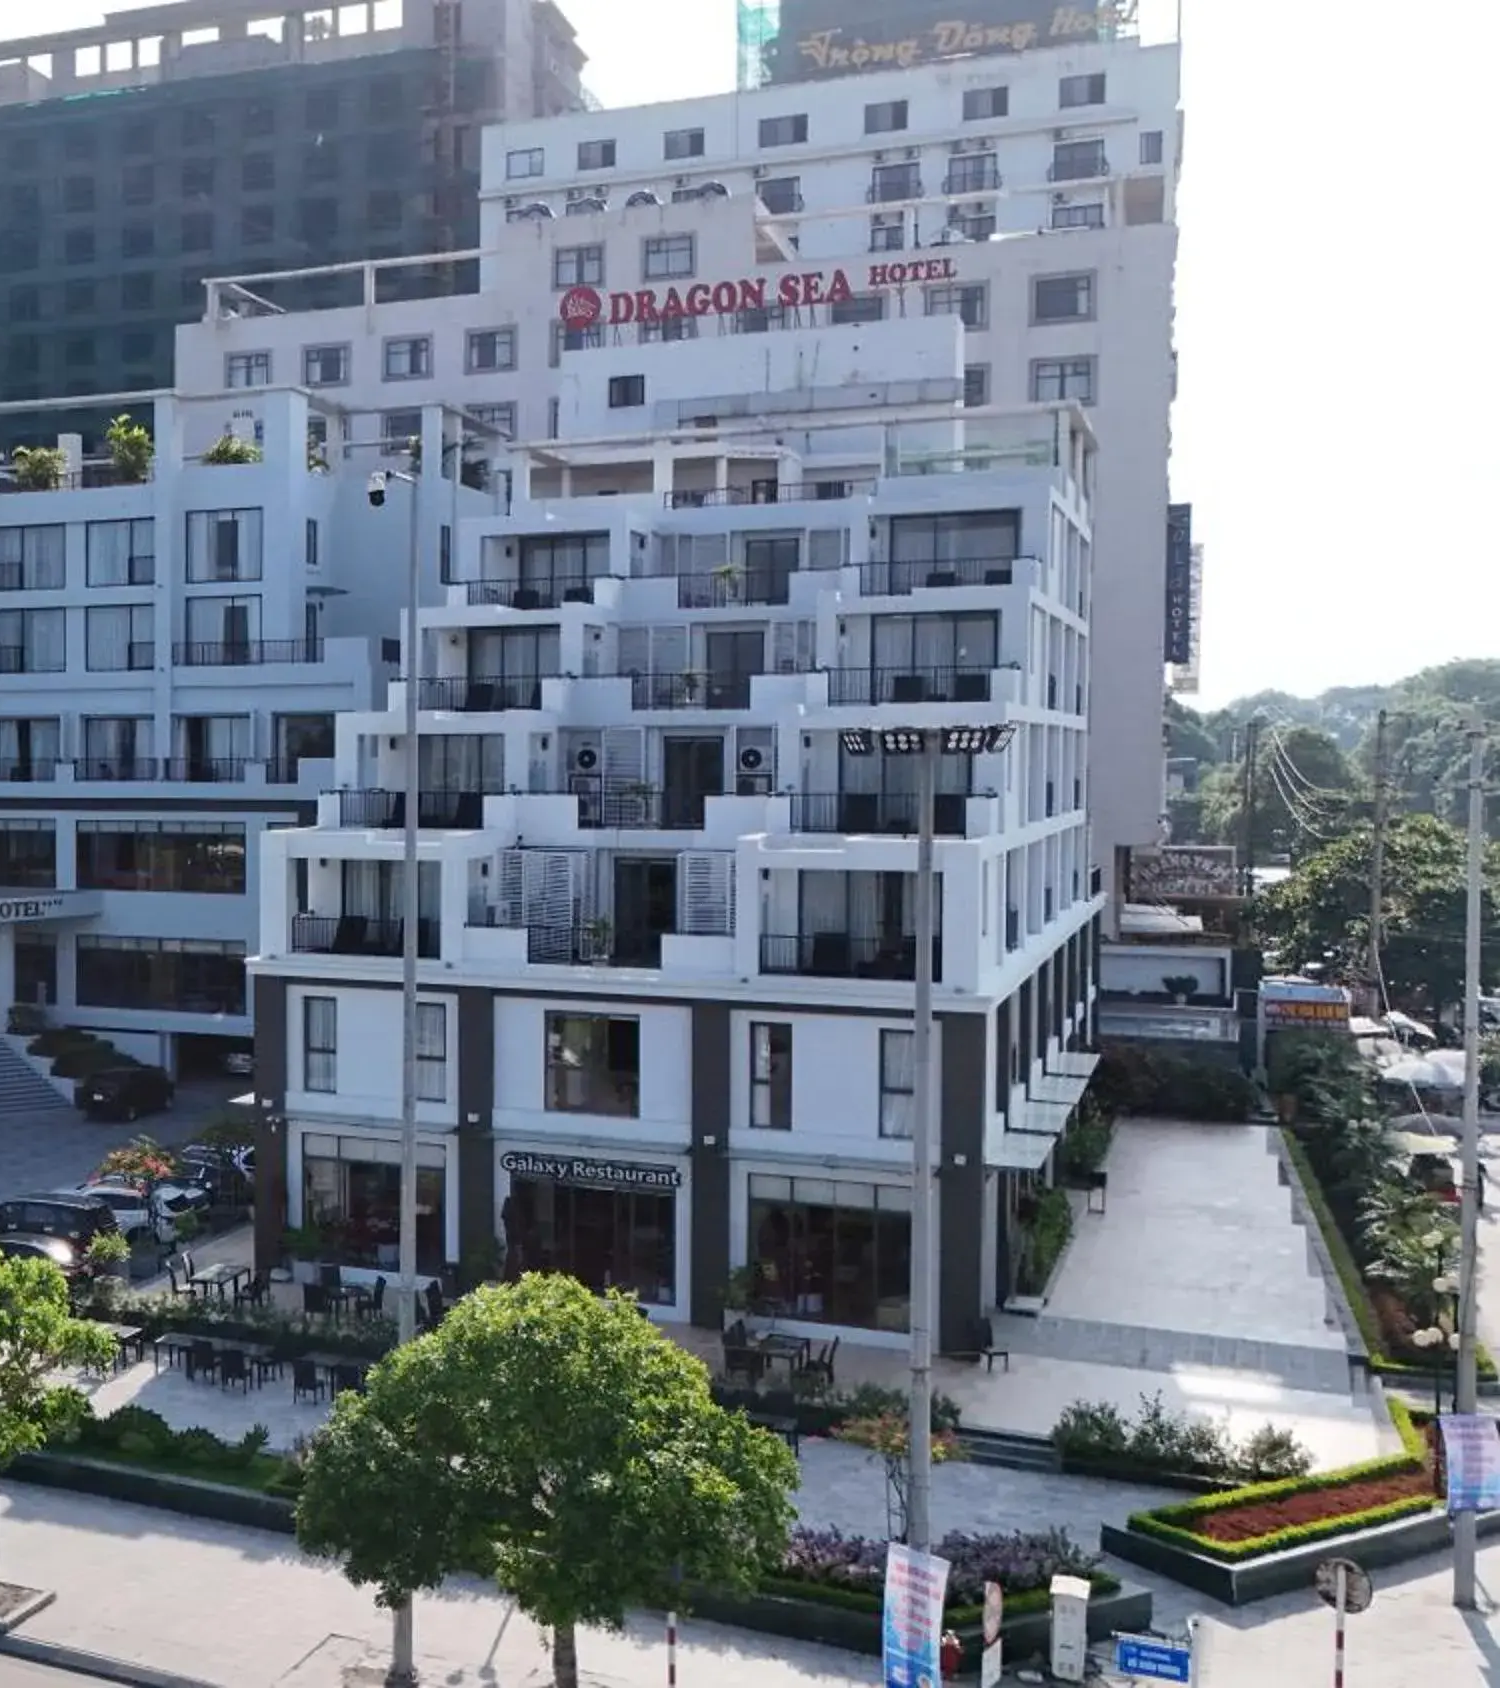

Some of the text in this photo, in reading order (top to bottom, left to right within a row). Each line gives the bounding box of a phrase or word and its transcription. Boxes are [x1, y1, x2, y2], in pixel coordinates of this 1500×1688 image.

[609, 258, 957, 324] DRAGON SEA HOTEL
[503, 1155, 678, 1185] Galaxy Restaurant
